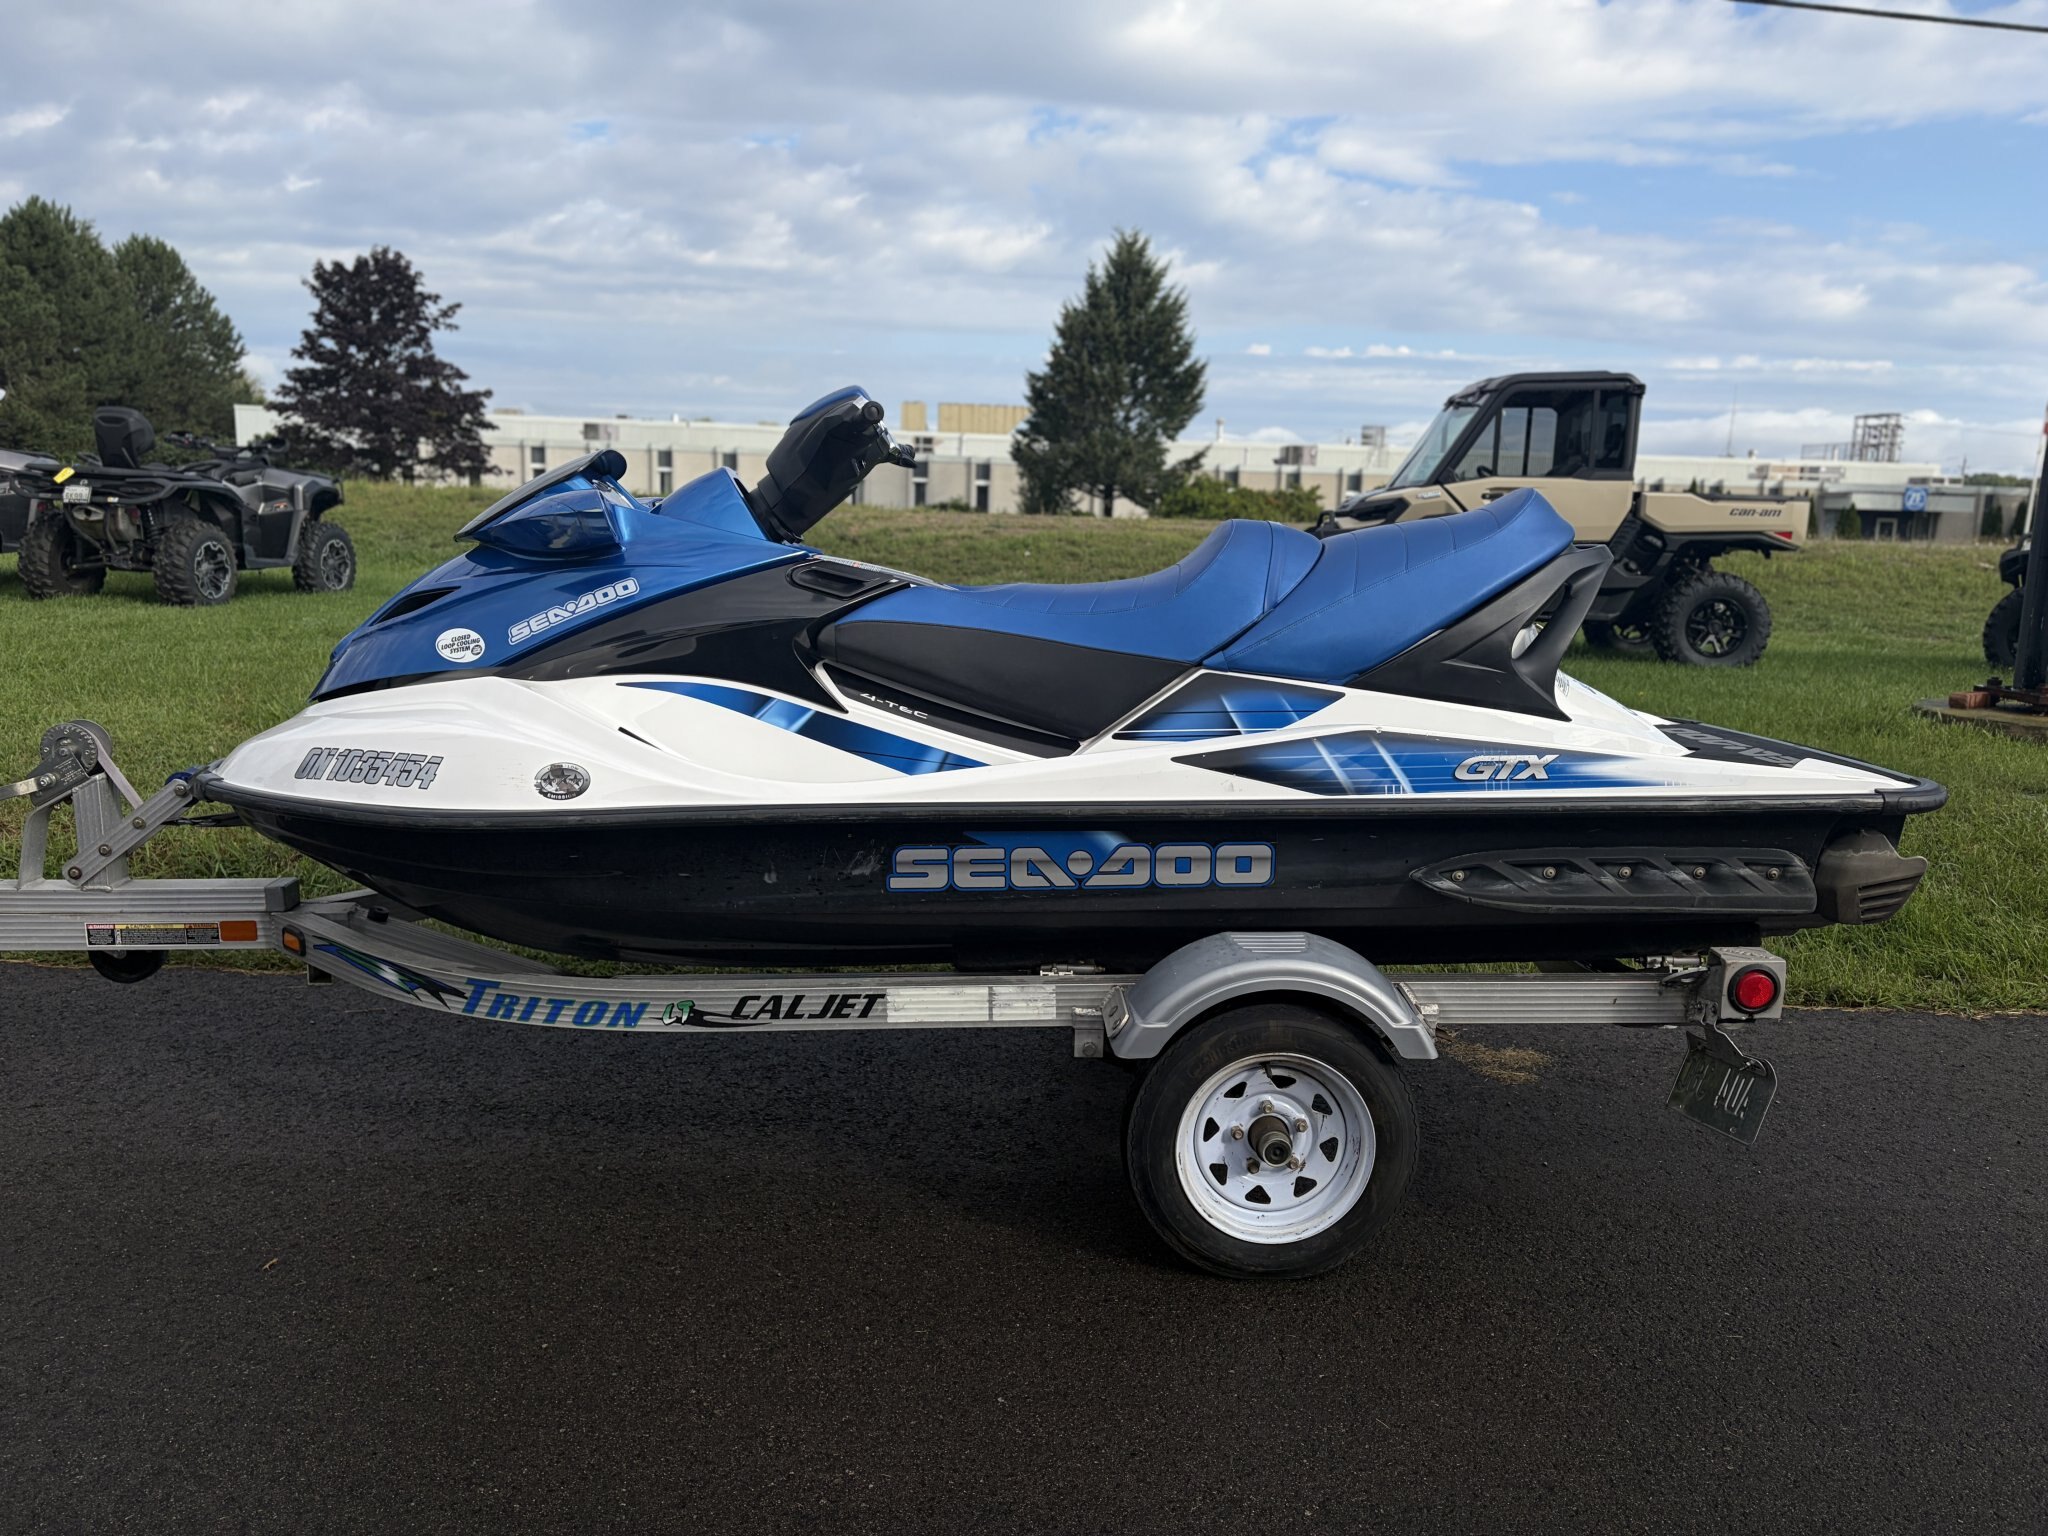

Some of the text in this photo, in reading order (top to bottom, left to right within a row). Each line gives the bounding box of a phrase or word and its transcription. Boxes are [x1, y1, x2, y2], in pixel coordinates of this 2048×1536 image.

[451, 634, 471, 642] CLOSED
[457, 638, 481, 647] COOLING
[450, 646, 470, 654] SYSTEM
[1454, 754, 1560, 781] GTX
[461, 977, 650, 1029] TRITON
[662, 1000, 696, 1025] LT
